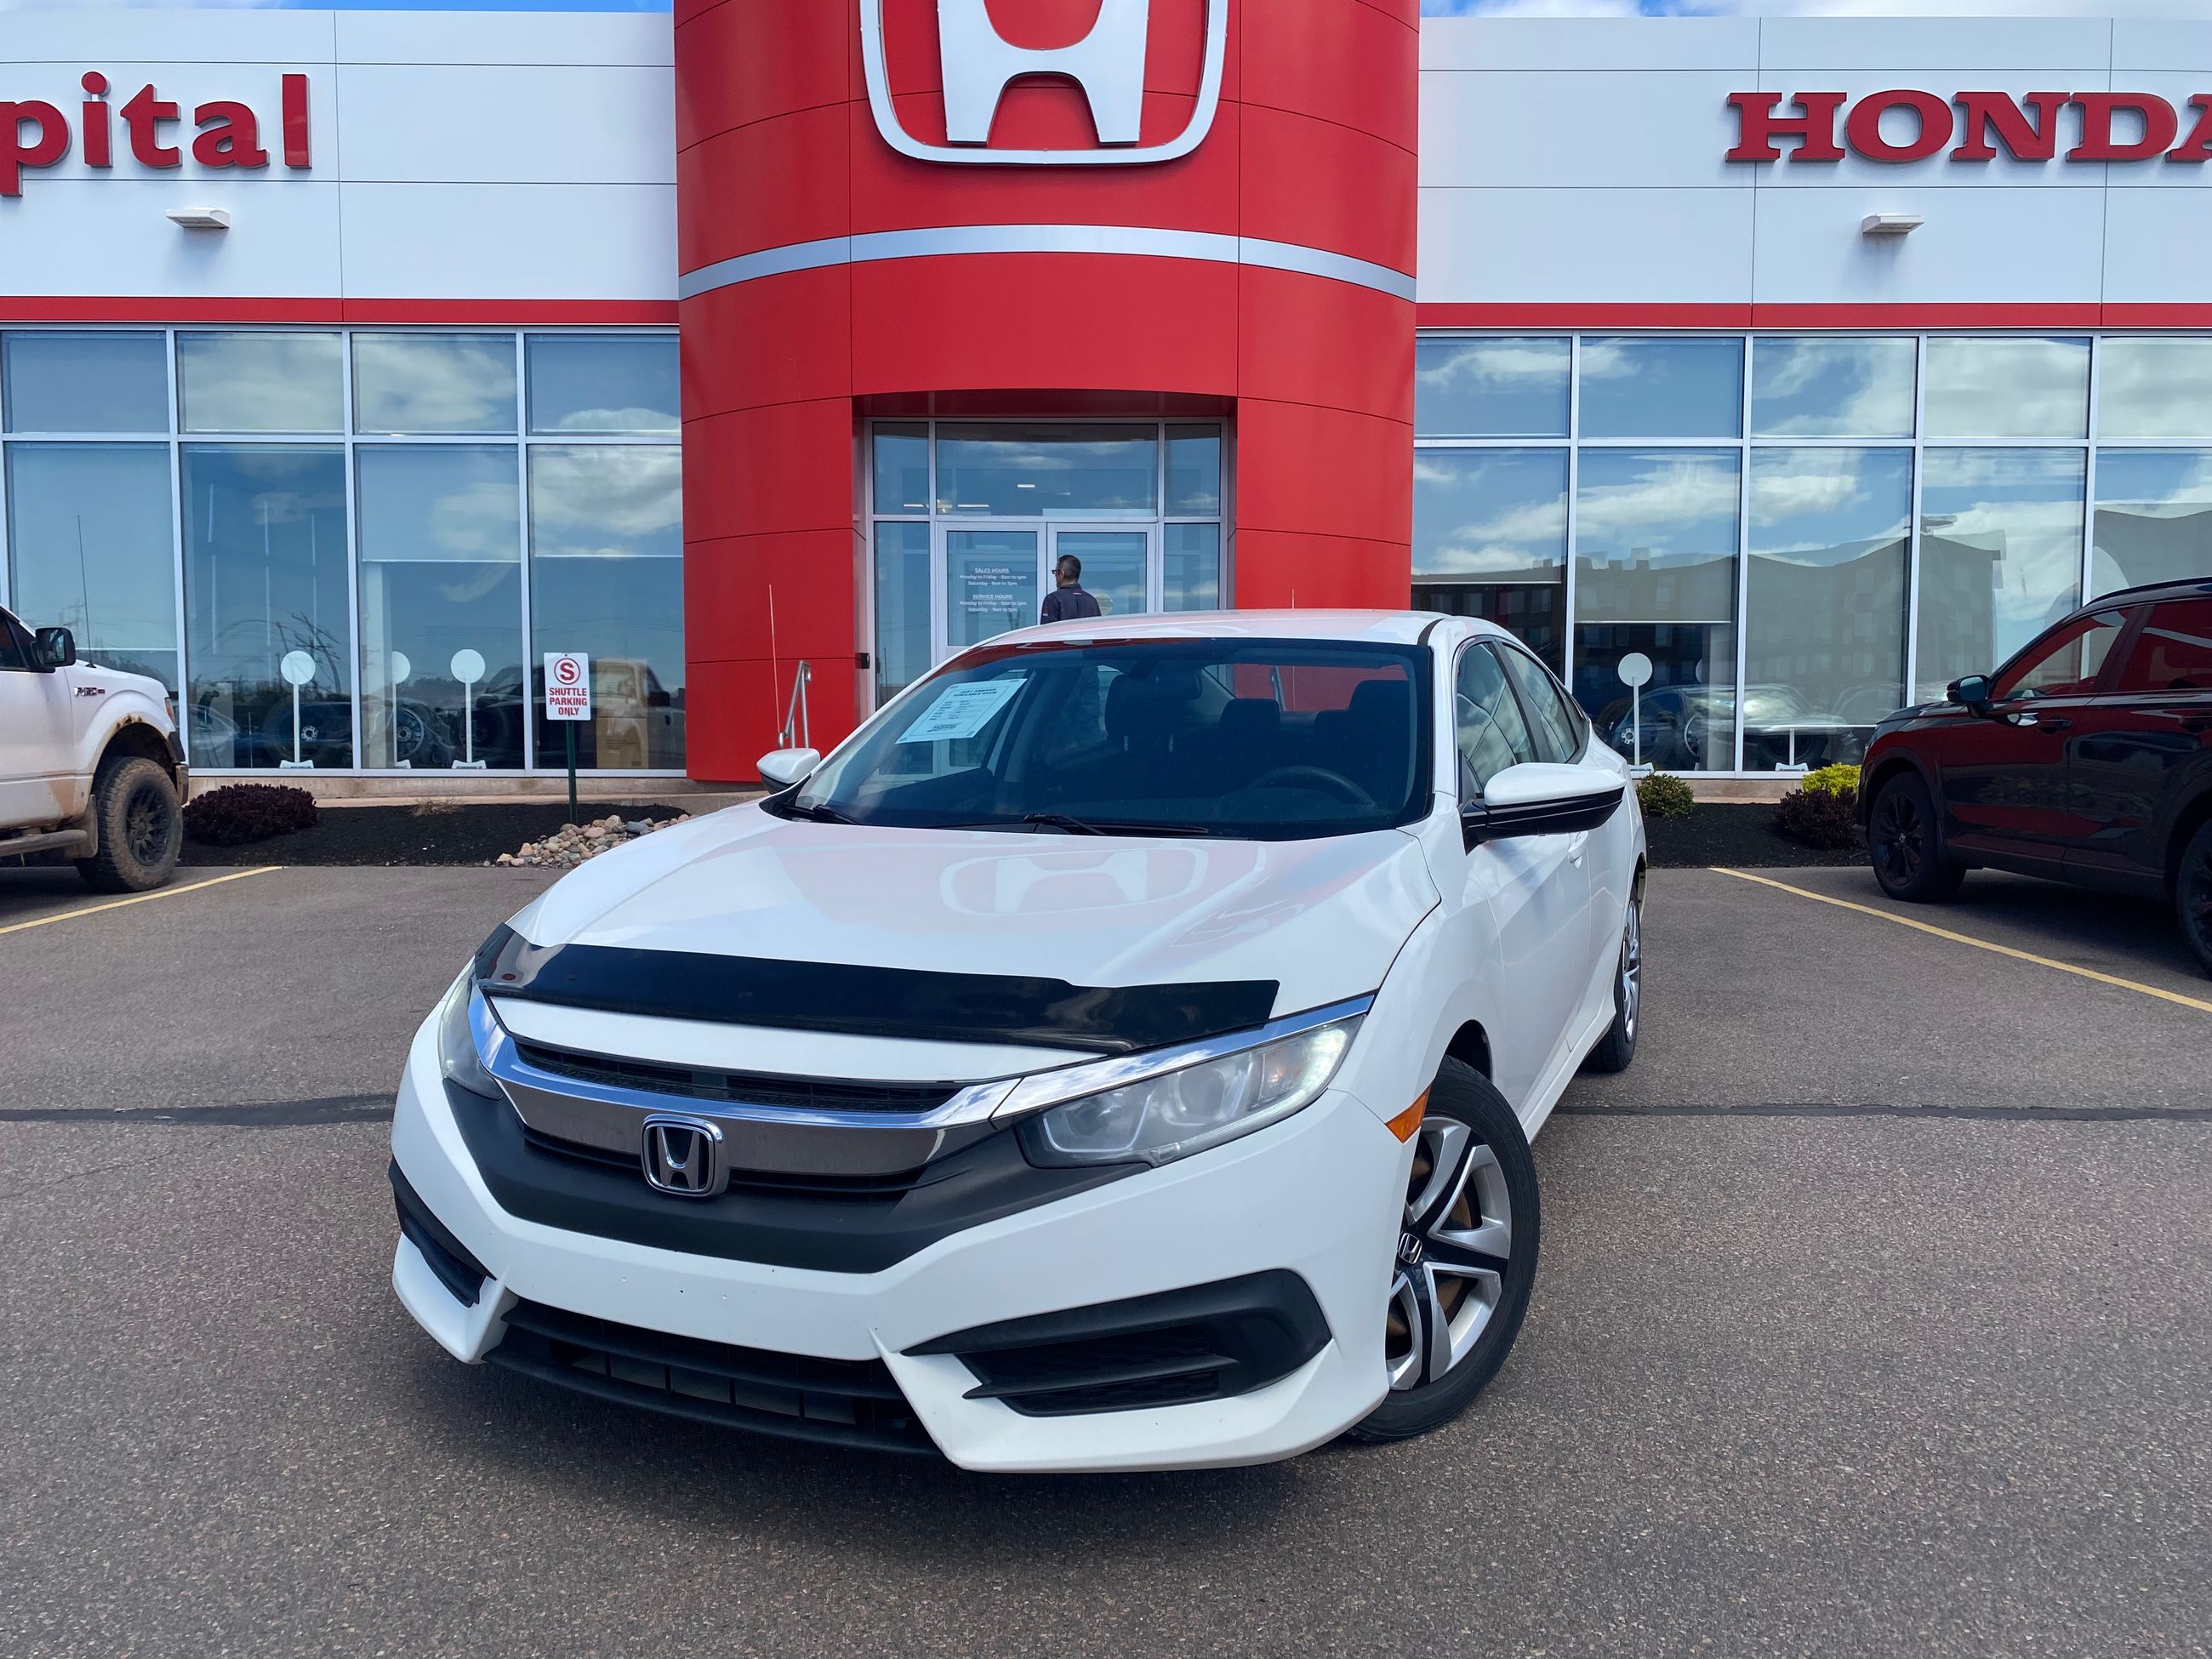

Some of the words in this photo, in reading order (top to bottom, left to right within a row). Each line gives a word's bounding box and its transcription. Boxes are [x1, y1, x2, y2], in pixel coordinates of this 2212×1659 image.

[559, 662, 575, 681] S
[549, 687, 587, 697] SHUTTLE
[549, 697, 588, 706] PARKING
[558, 707, 579, 715] ONLY
